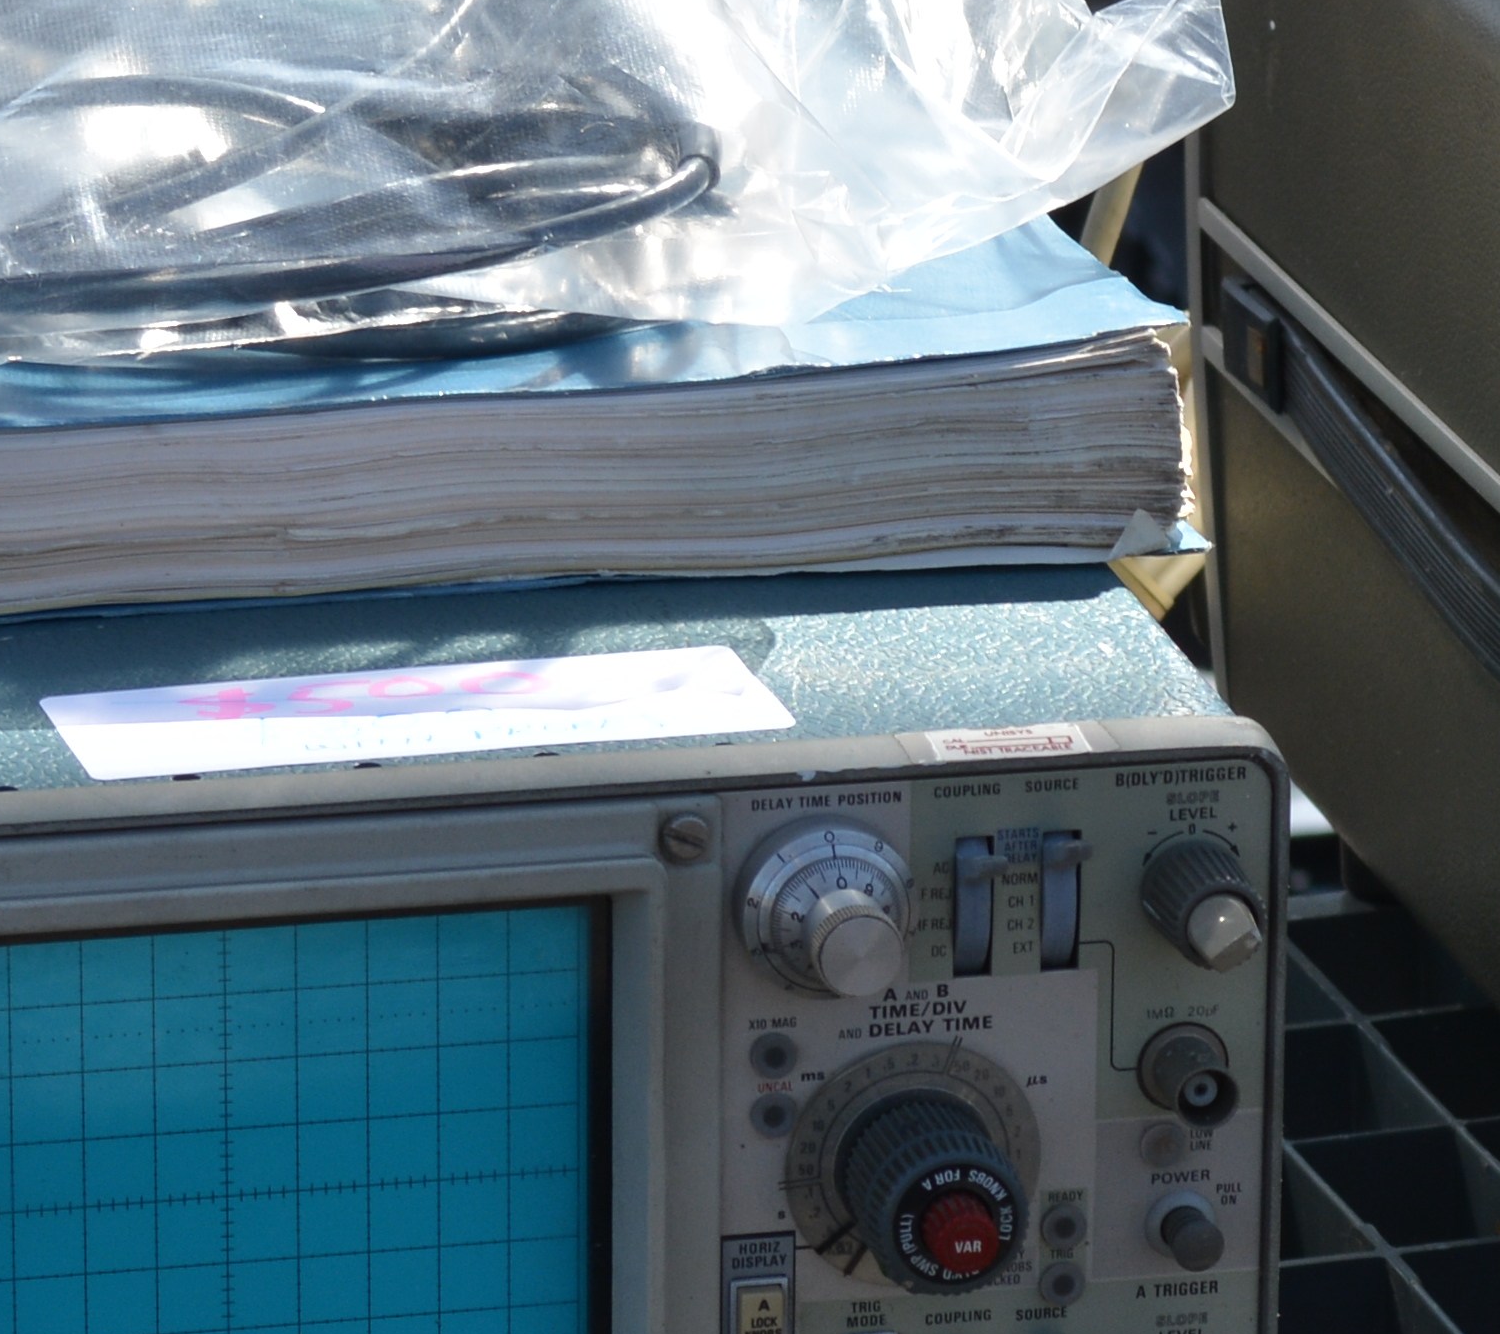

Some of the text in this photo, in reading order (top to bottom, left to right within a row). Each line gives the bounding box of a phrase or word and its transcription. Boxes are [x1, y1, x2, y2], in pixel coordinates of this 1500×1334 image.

[934, 782, 1000, 798] COUPLING
[1025, 778, 1079, 792] SOURCE
[752, 791, 901, 811] DELAY TIME POSITION
[1169, 806, 1217, 821] LEVEL
[869, 1001, 967, 1020] TIME/DIV
[839, 1015, 993, 1039] AND DELAY TIME
[1151, 1169, 1210, 1185] POWER
[1048, 1191, 1084, 1203] READY
[739, 1242, 780, 1255] HORIZ
[955, 1240, 982, 1253] VAR
[732, 1254, 787, 1268] DISPLAY
[1136, 1280, 1218, 1299] A TRIGGER
[851, 1301, 881, 1313] TRIG
[1015, 1307, 1067, 1321] SOURCE
[751, 1317, 777, 1329] LOCK
[846, 1314, 887, 1328] MODE
[925, 1310, 992, 1326] COUPLING
